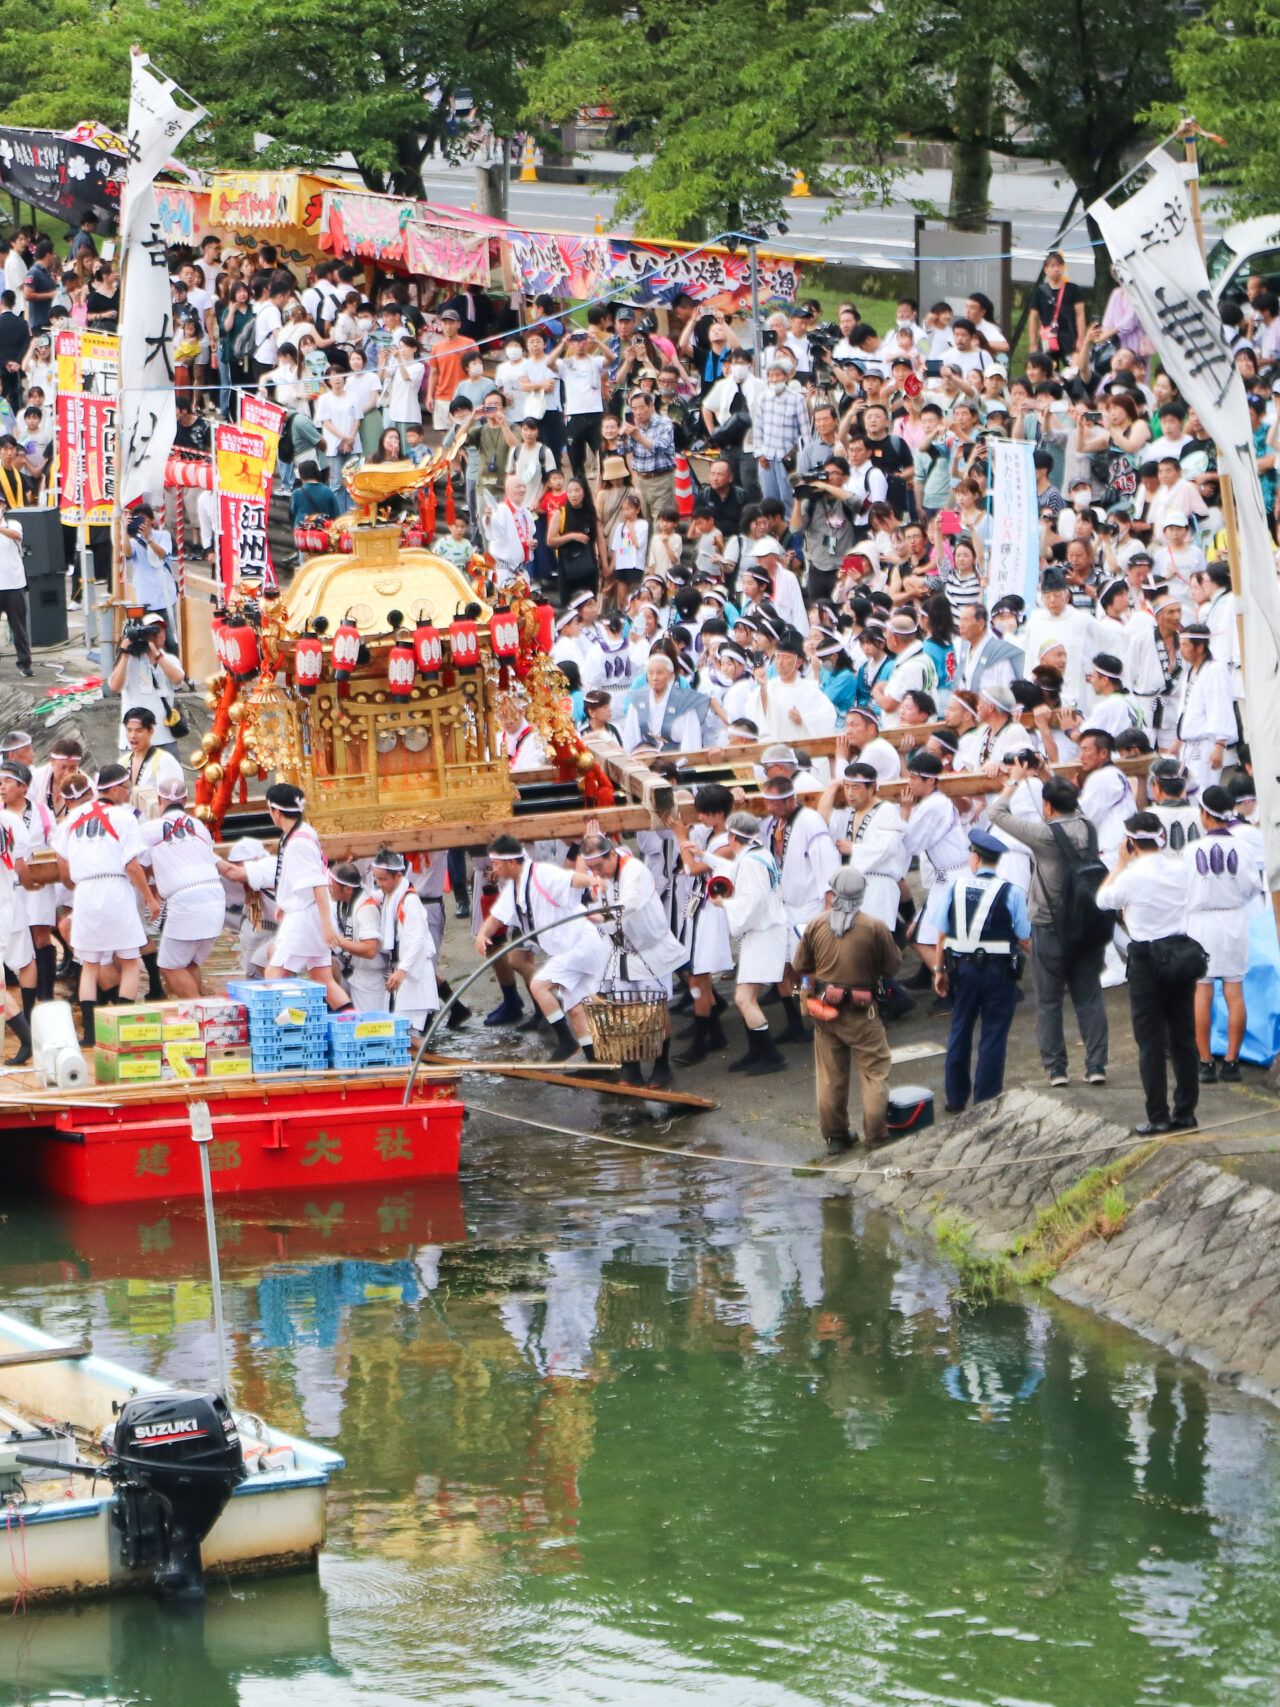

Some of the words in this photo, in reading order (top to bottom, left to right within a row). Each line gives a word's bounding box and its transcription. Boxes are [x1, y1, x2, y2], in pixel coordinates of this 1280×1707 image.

[629, 251, 726, 287] いか焼
[134, 1126, 414, 1178] 建部大社
[134, 1418, 199, 1440] SUZUKI
